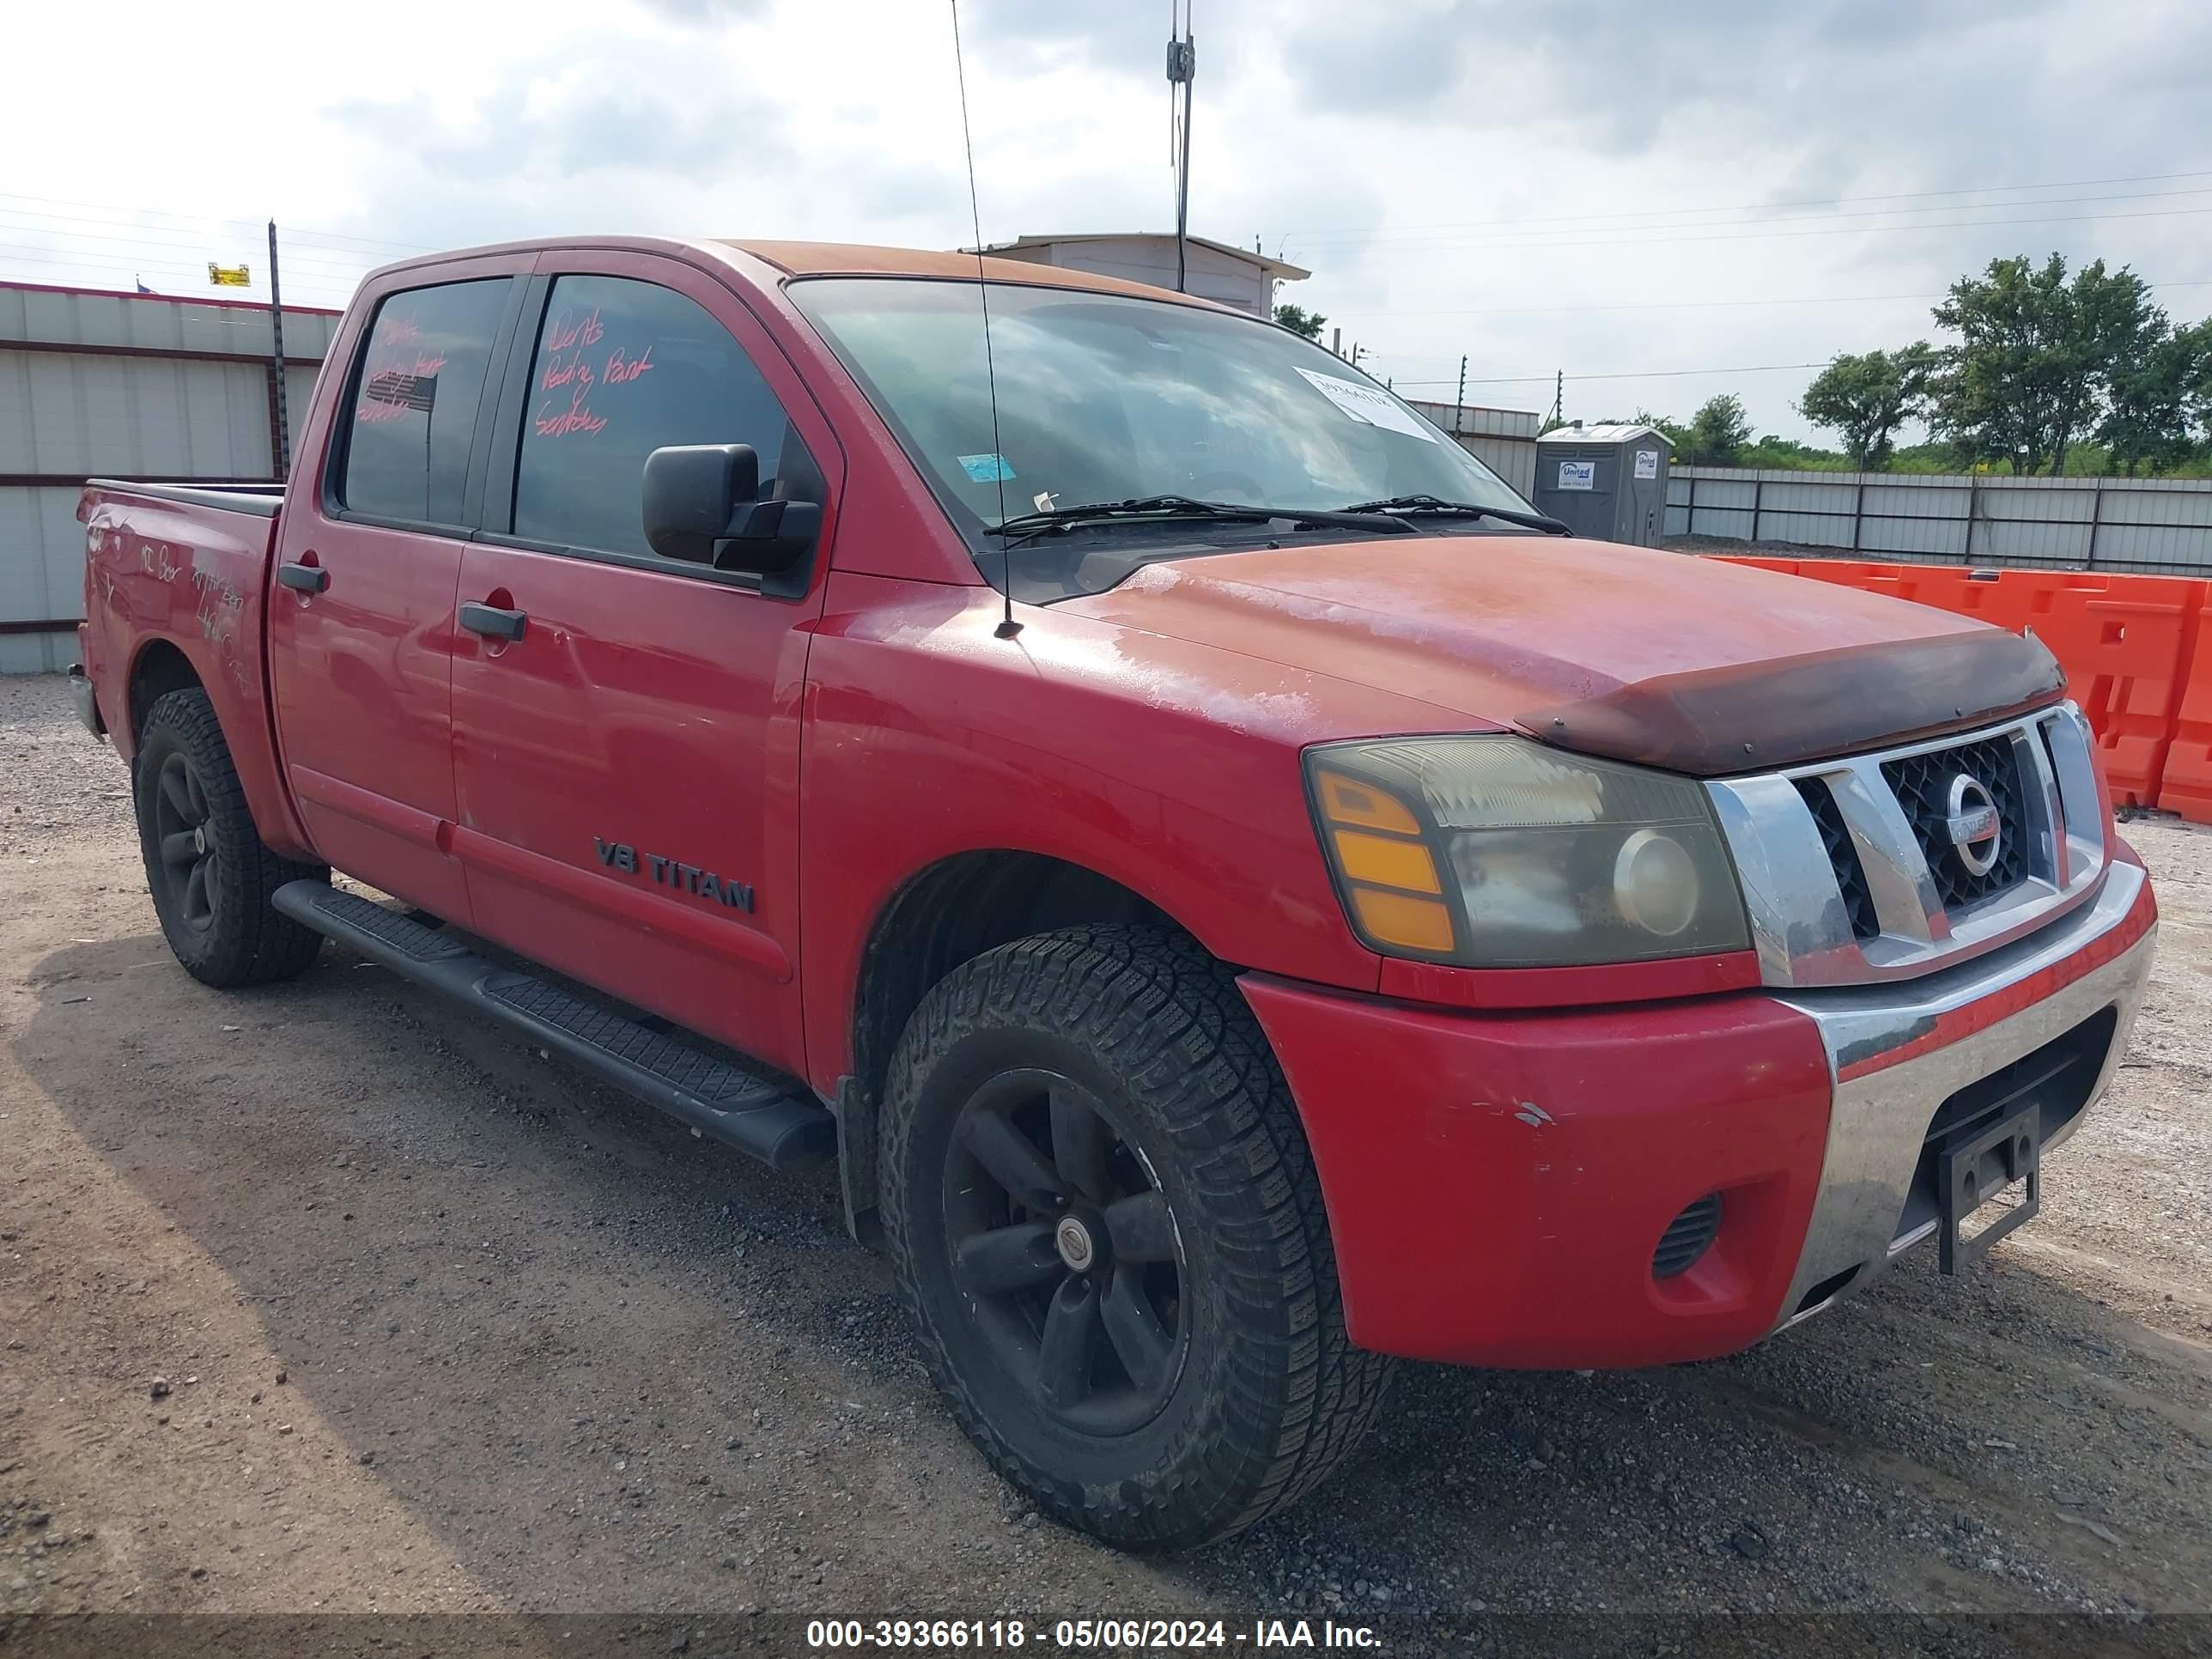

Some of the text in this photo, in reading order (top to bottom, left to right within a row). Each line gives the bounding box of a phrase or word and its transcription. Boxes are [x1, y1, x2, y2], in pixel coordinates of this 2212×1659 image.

[1564, 466, 1590, 476] United
[593, 836, 756, 915] V8 TITAN
